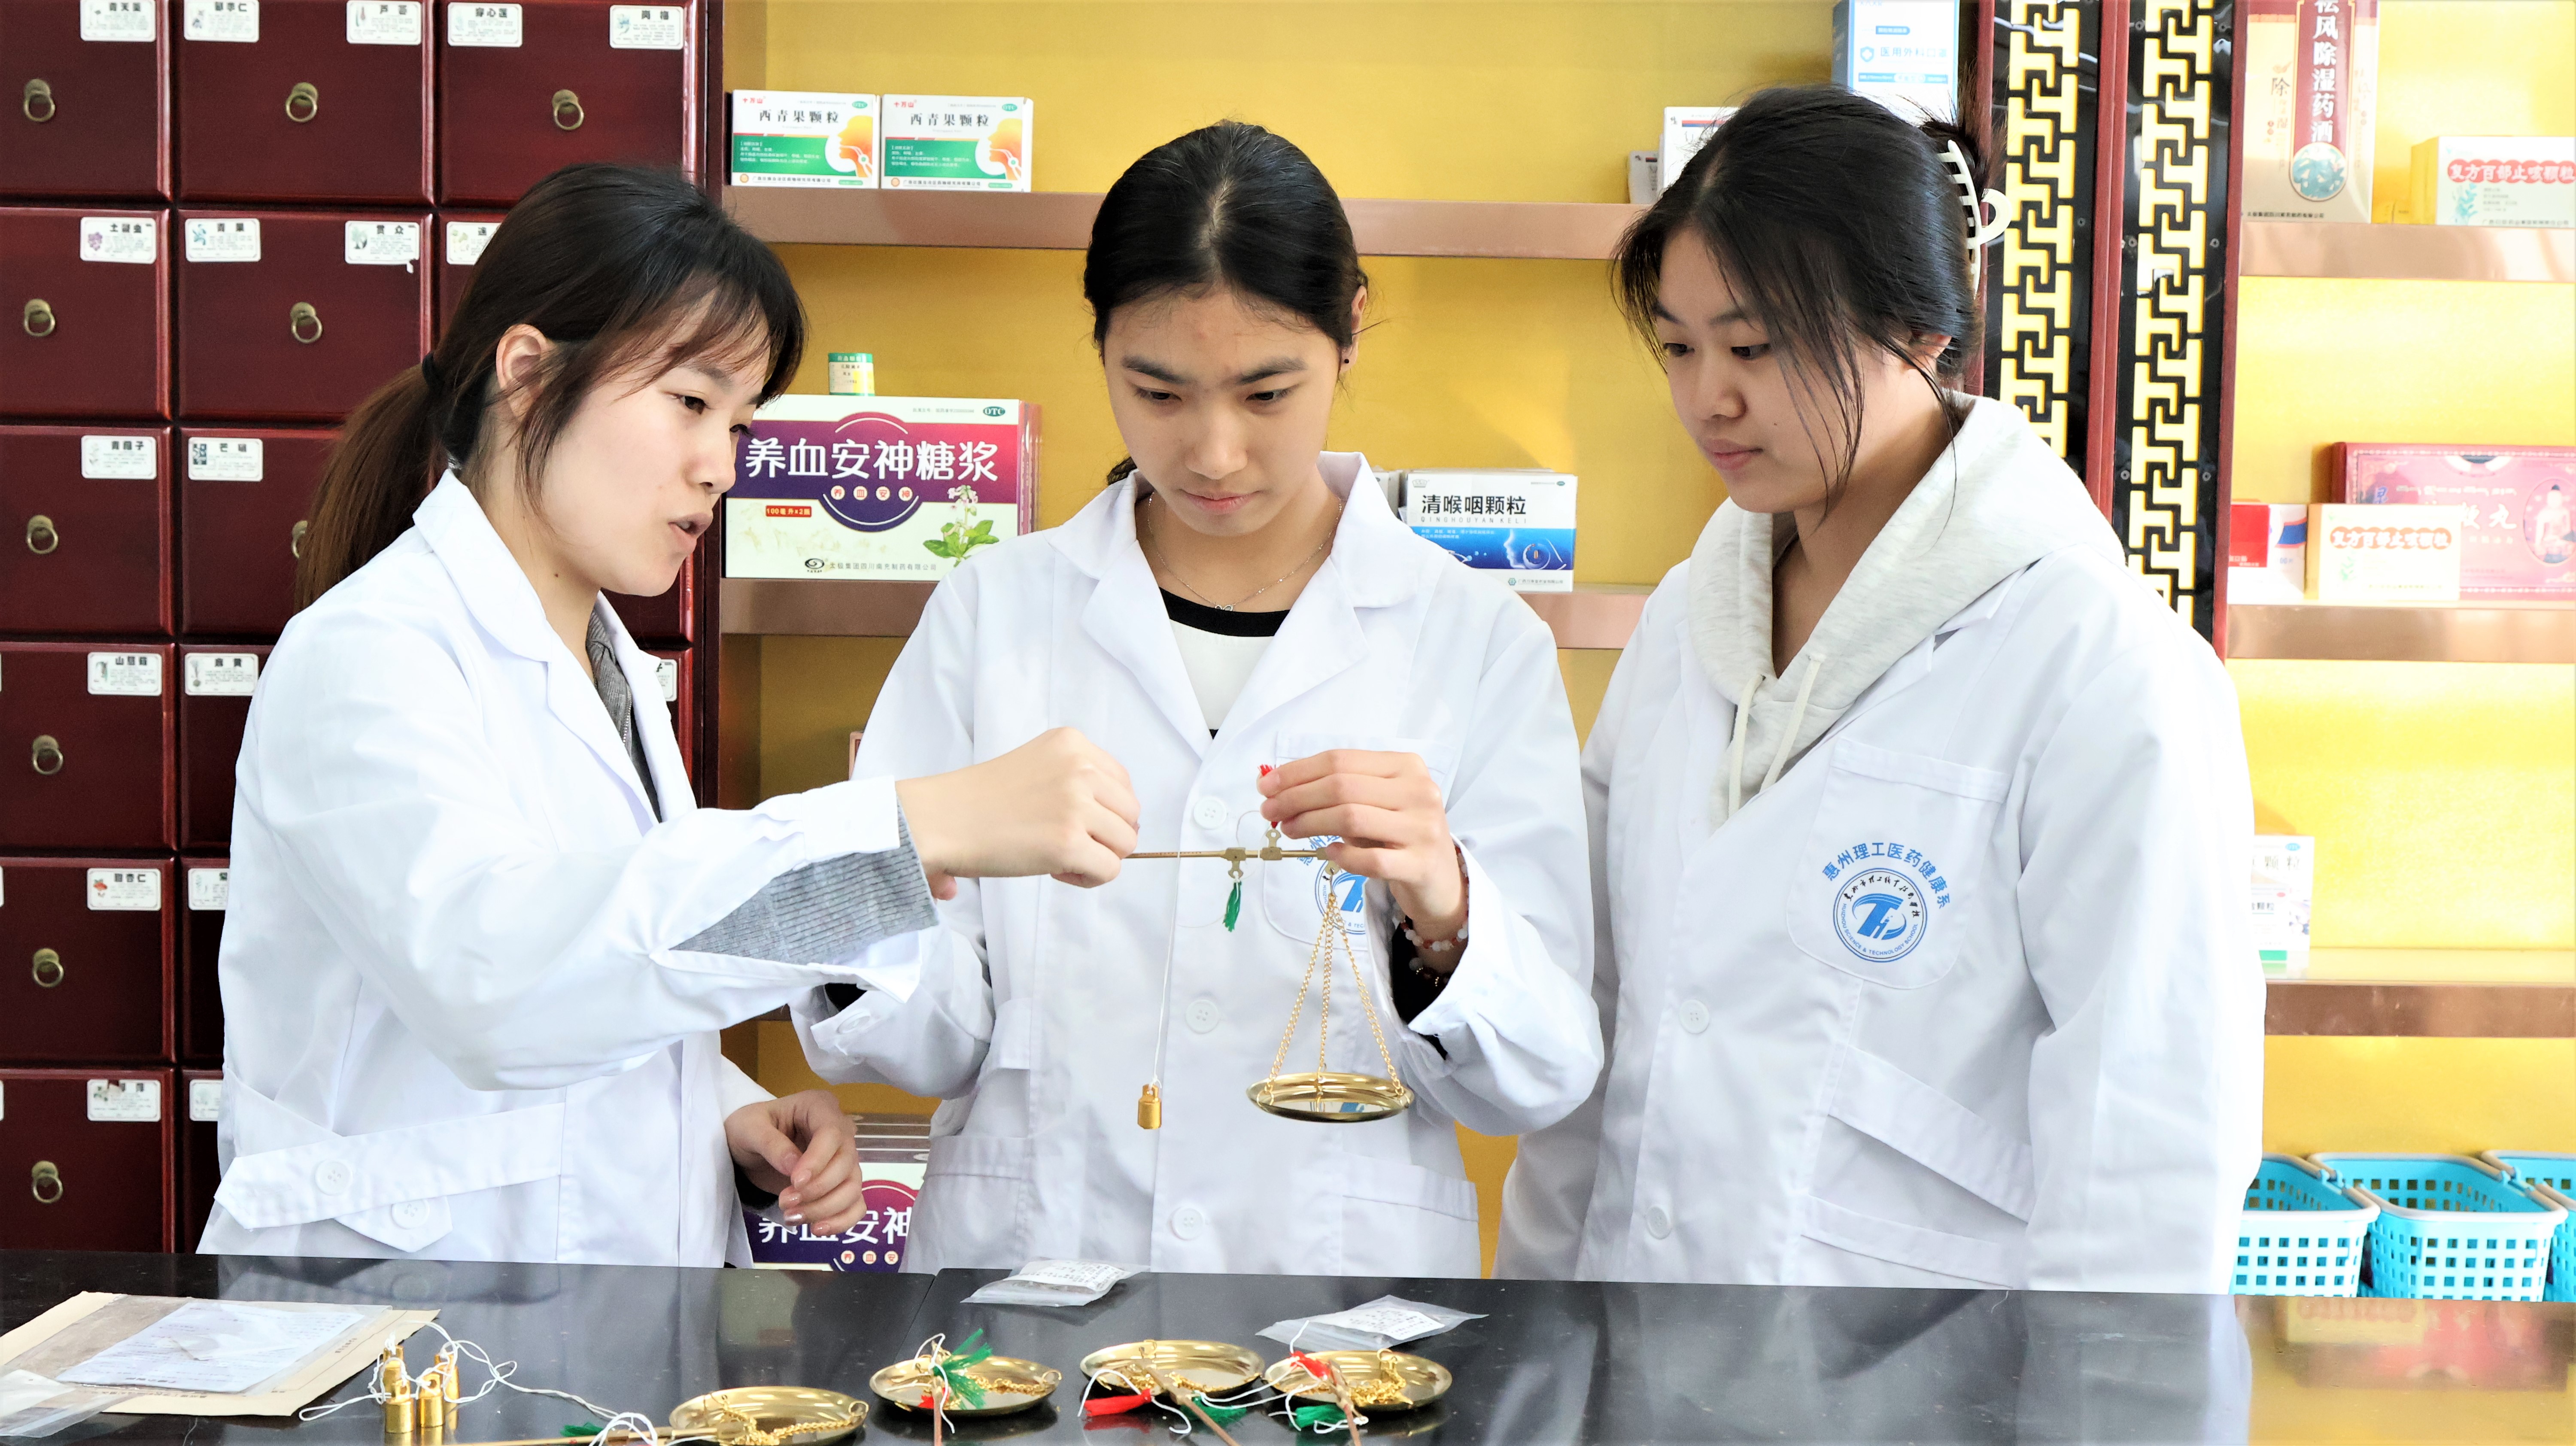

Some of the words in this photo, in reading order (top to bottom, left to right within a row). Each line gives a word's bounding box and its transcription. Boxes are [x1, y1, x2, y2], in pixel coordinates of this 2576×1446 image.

[476, 7, 507, 18] 穿心莲
[1880, 47, 1947, 57] 医用外科口罩
[2312, 0, 2340, 143] 祛风除湿药酒
[759, 109, 838, 123] 西青果颗粒
[911, 112, 989, 127] 西青果颗粒
[984, 407, 1004, 416] OTC
[745, 437, 999, 482] 养血安神糖浆
[834, 489, 910, 498] 养血安神
[1422, 494, 1526, 515] 清喉咽颗粒
[829, 562, 936, 571] 太极集团四川南充制药有限公司
[1822, 842, 1950, 909] 惠州理工医药健康系
[1844, 929, 1862, 950] SCIENCE
[1869, 943, 1905, 956] TECHNOLOGY
[1905, 923, 1918, 945] SCHOOL
